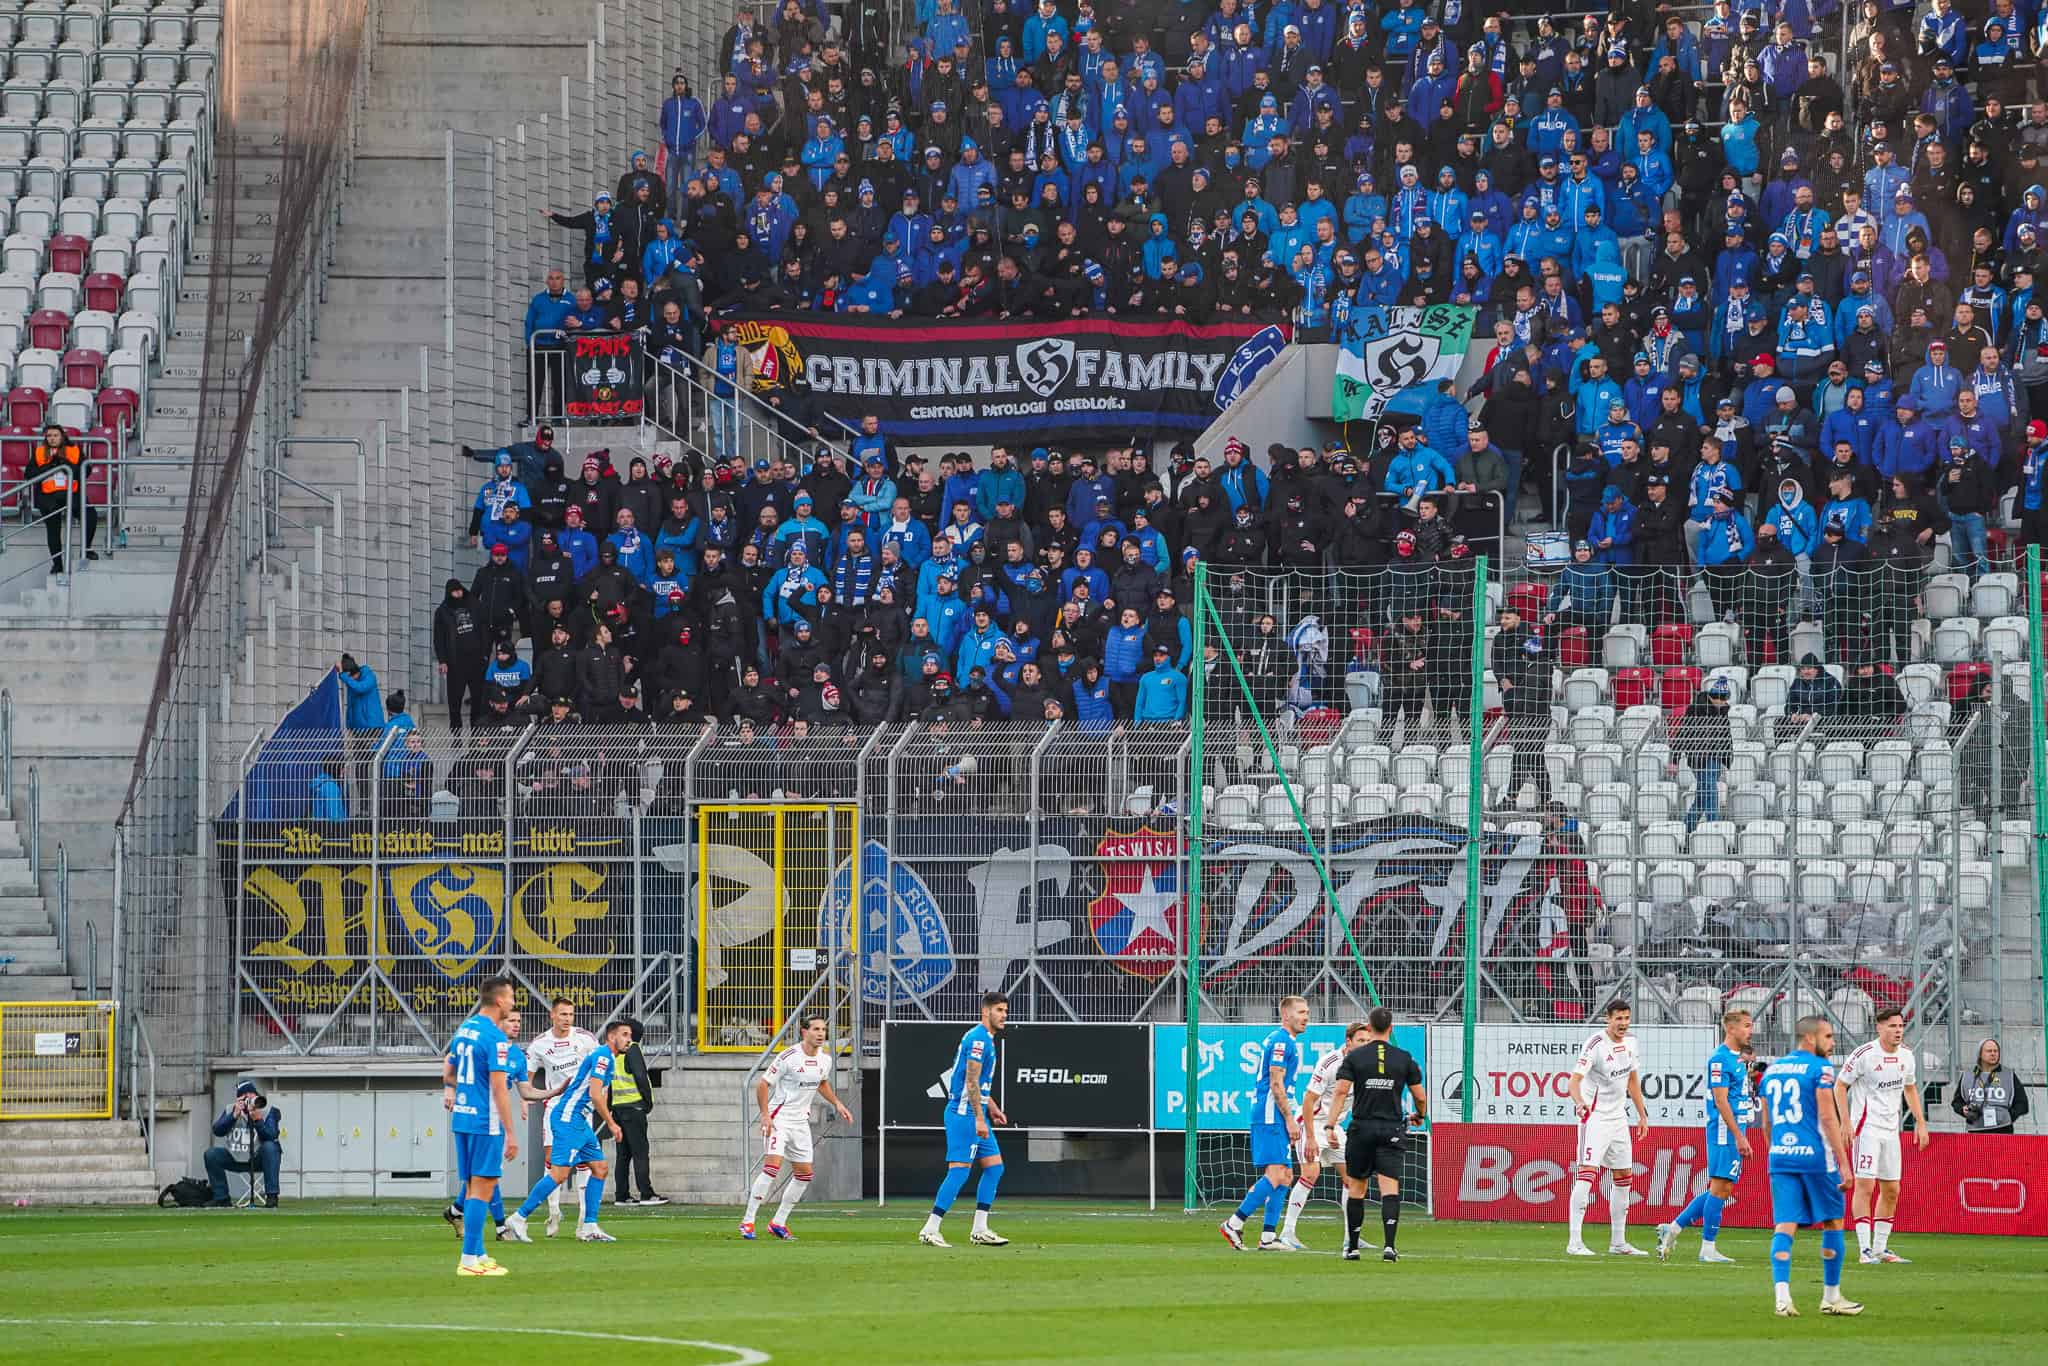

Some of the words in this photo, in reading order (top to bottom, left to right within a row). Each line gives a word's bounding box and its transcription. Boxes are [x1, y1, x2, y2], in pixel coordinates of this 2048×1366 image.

[805, 353, 1020, 397] CRIMINAL
[1075, 350, 1225, 392] FAMILY
[910, 404, 974, 420] CENTRUM
[981, 401, 1047, 418] PATOLOGII
[281, 826, 322, 854] Nie
[462, 829, 504, 854] nas
[816, 954, 828, 965] 26
[66, 1037, 79, 1049] 27
[1507, 1043, 1568, 1056] PARTNER
[1488, 1071, 1574, 1098] TOYO
[1765, 1078, 1804, 1125] 23
[1585, 1147, 1593, 1161] 5
[1860, 1154, 1873, 1169] 27
